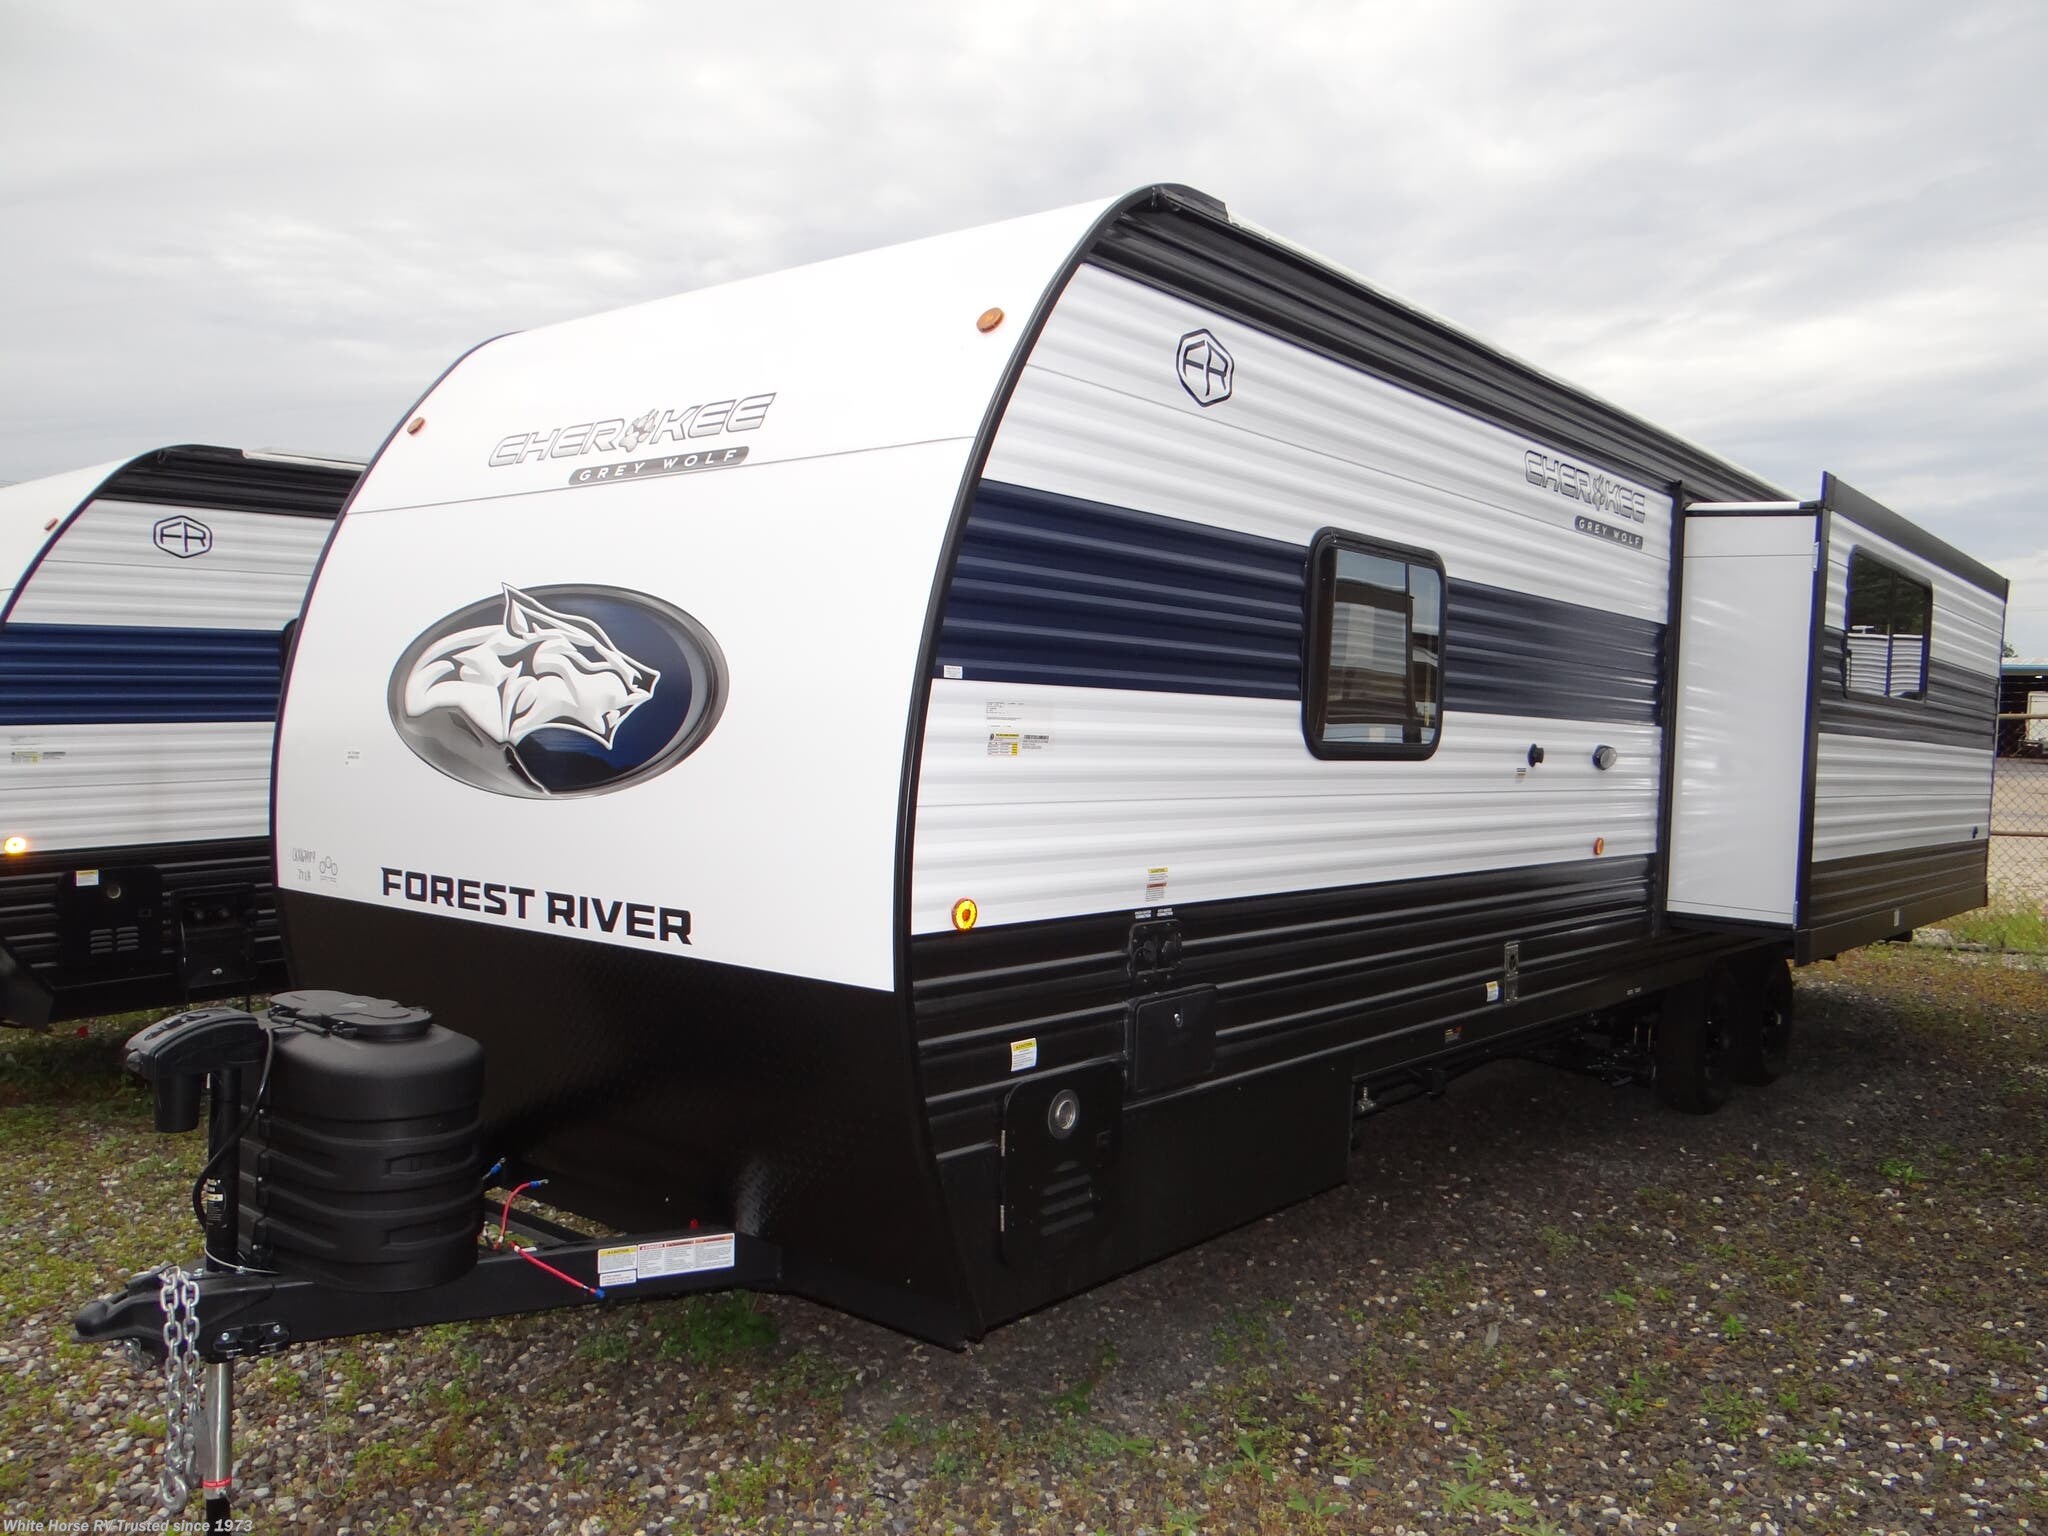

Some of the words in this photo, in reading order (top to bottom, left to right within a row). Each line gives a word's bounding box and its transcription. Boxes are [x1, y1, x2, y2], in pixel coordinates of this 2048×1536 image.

[579, 462, 645, 481] GREY
[663, 449, 737, 470] WOLF
[1579, 518, 1608, 535] GREY
[1612, 529, 1641, 546] WOLF
[380, 867, 536, 919] FOREST
[545, 890, 693, 945] RIVER
